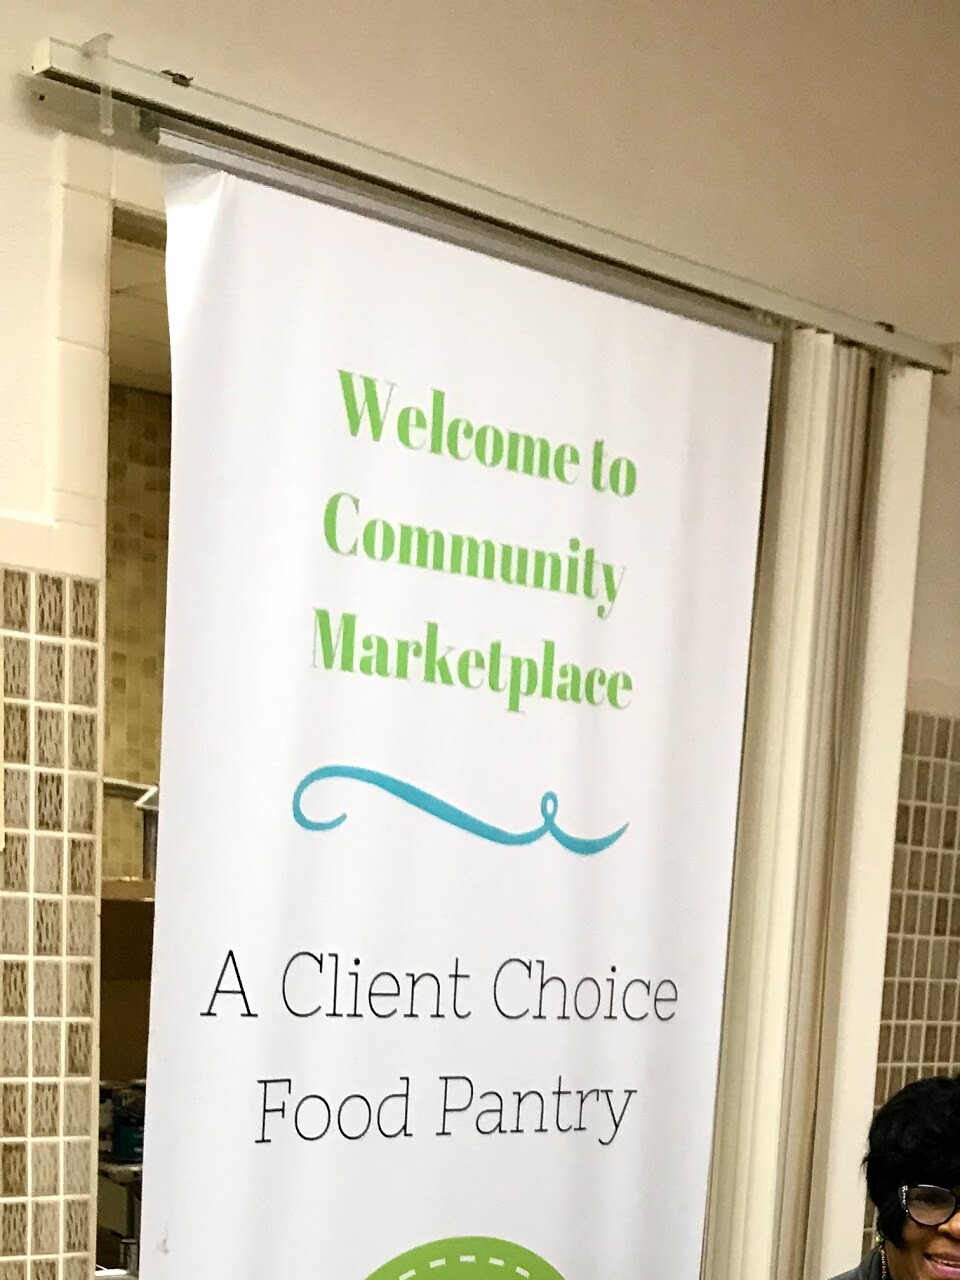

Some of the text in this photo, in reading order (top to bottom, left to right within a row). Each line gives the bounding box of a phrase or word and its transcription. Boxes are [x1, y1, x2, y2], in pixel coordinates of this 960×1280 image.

[336, 368, 638, 498] Welcome to
[322, 490, 627, 620] Community
[311, 606, 634, 714] Marketplace
[200, 949, 678, 1022] A Client Choice
[255, 1074, 638, 1145] Food Pantry
